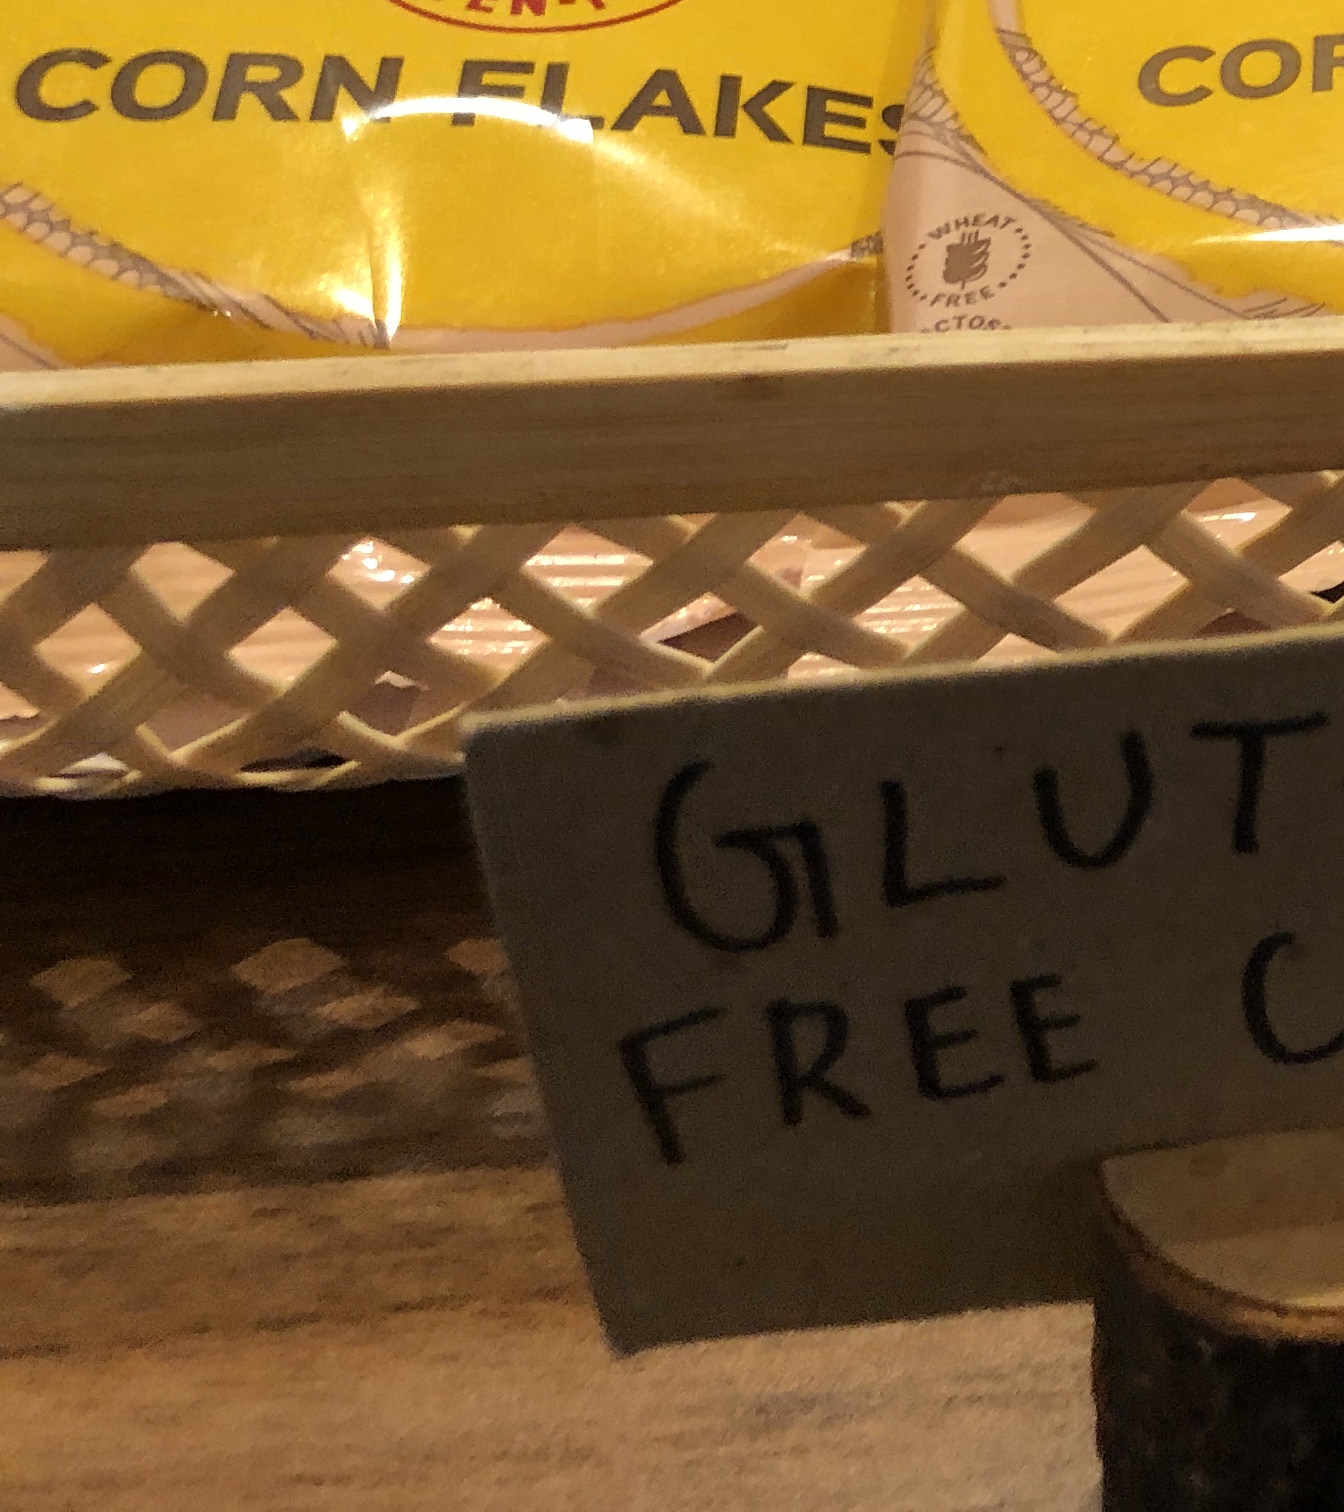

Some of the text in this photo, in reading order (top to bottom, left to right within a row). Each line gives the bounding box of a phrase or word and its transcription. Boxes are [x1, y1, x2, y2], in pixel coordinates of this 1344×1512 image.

[14, 47, 404, 125] CORN
[928, 213, 1016, 240] WHEAT
[930, 285, 995, 307] FREE
[616, 974, 1098, 1165] FREE
